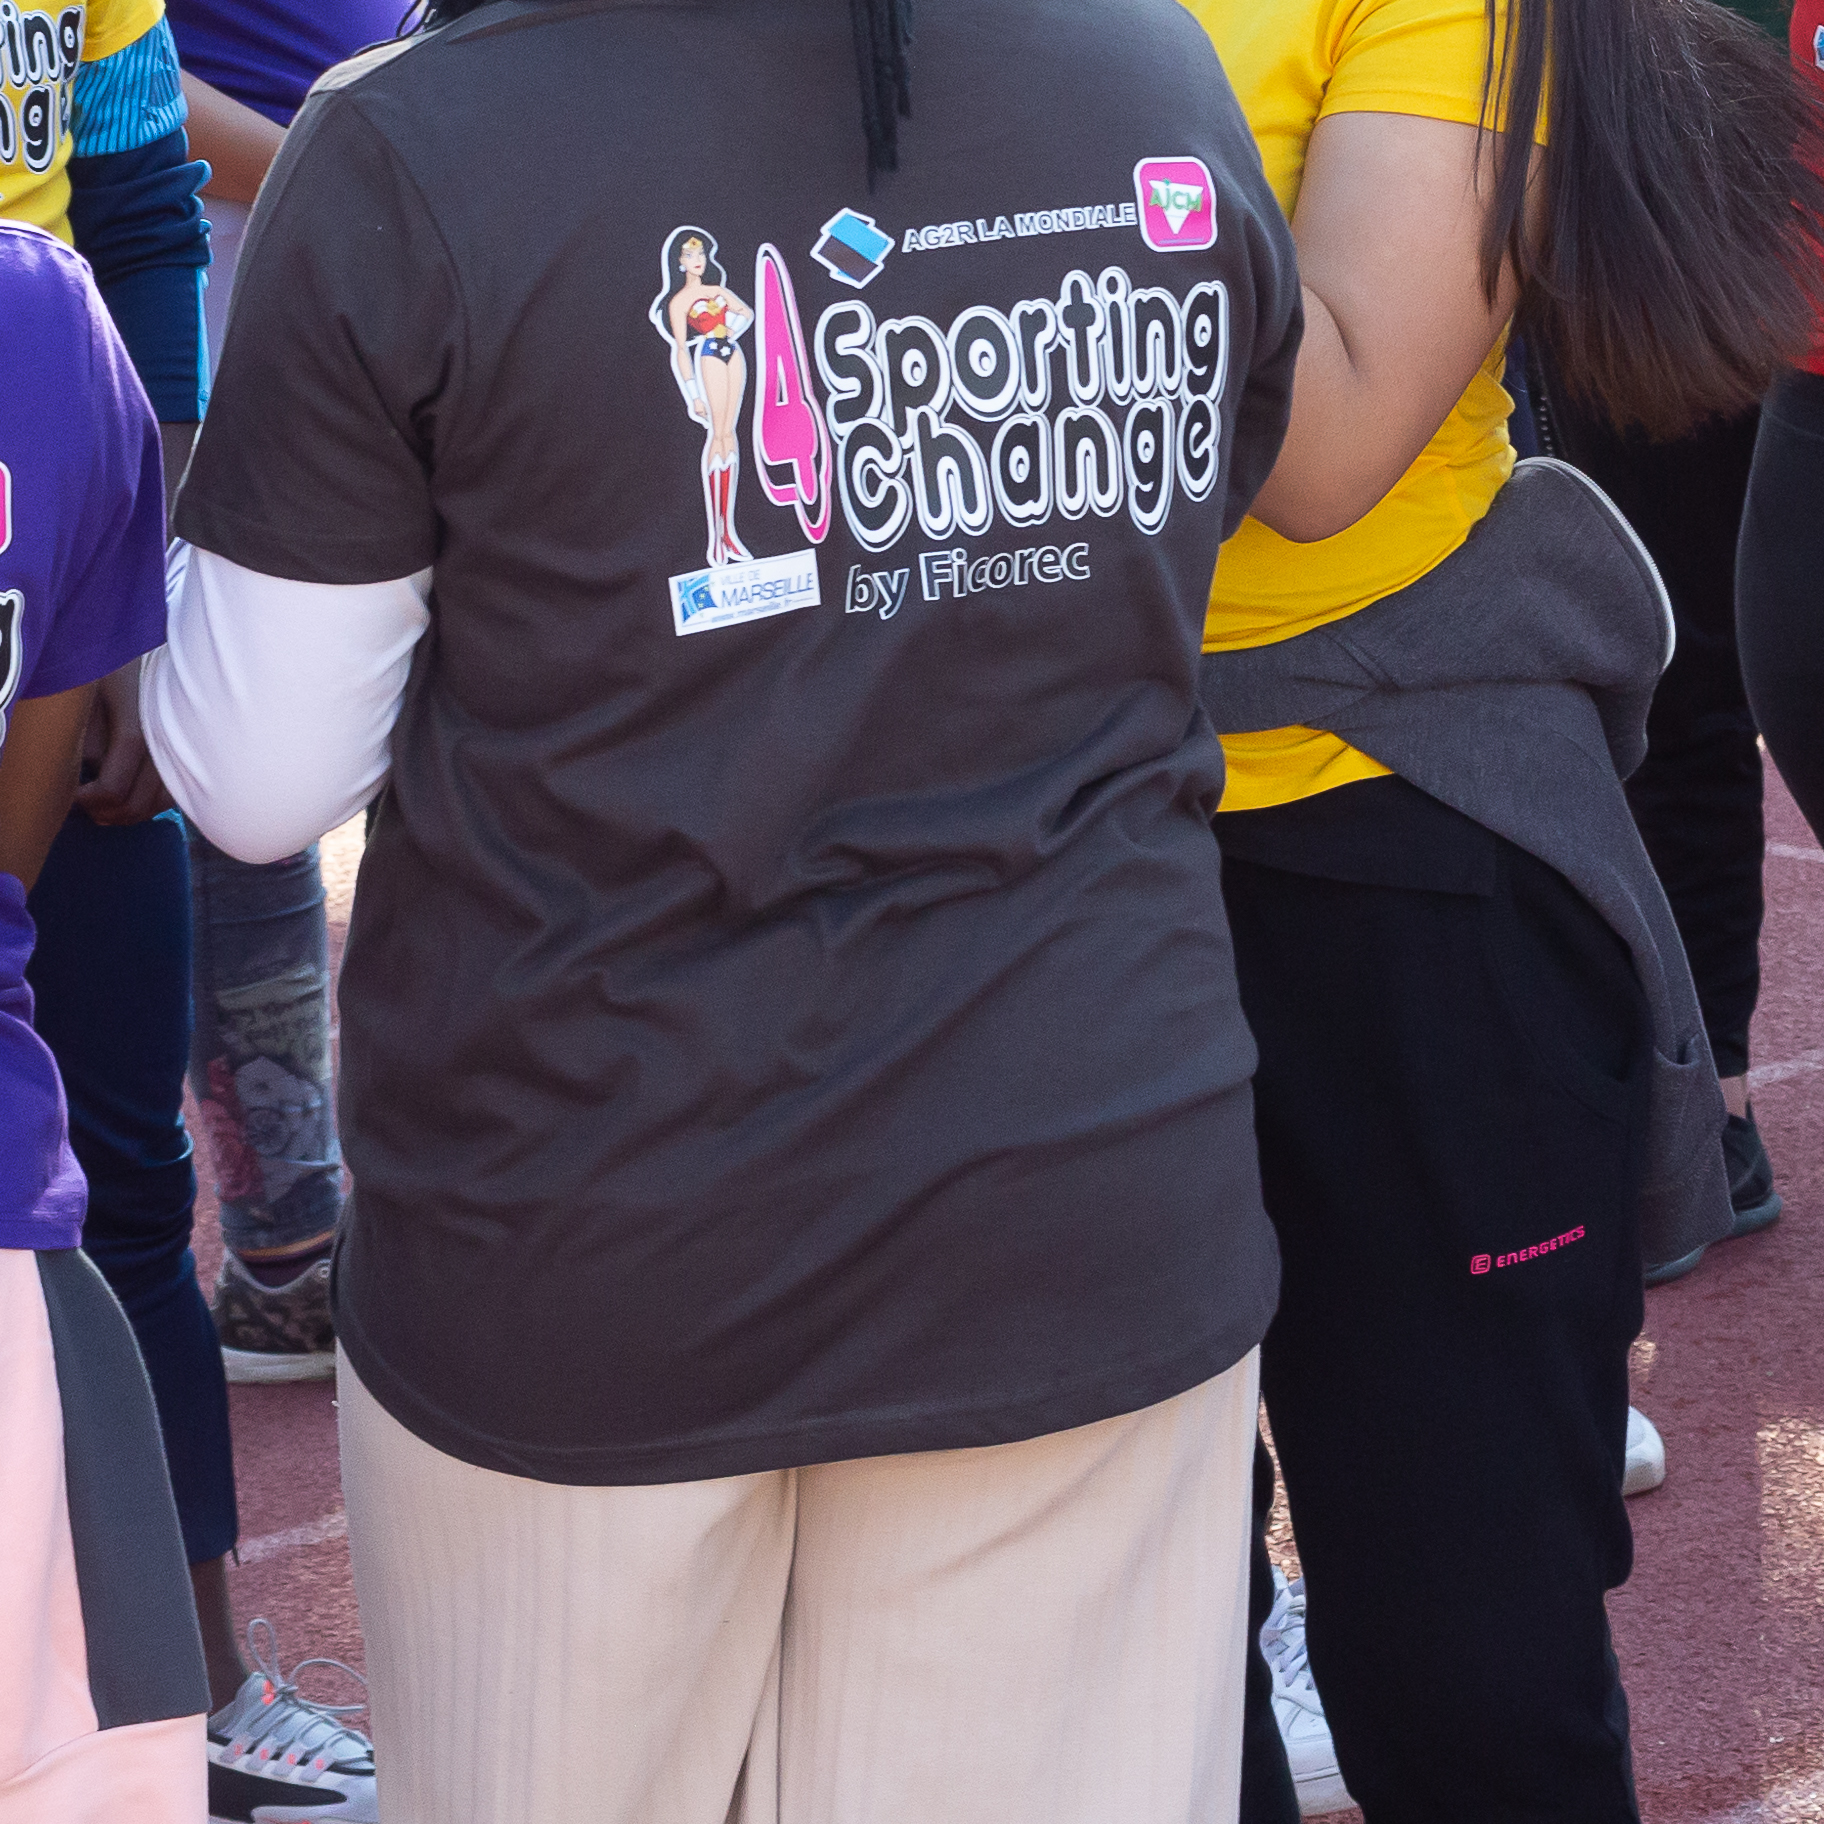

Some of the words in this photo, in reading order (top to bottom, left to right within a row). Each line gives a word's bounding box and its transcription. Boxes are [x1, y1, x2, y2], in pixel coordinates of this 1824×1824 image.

[902, 221, 977, 253] AG2R
[976, 216, 1015, 242] LA
[1013, 202, 1137, 237] MONDIALE
[753, 242, 831, 543] 4
[814, 266, 1229, 456] Sporting
[838, 394, 1222, 553] Change
[722, 573, 814, 608] MARSEILLE
[845, 564, 910, 620] by
[918, 542, 1090, 602] Ficorec
